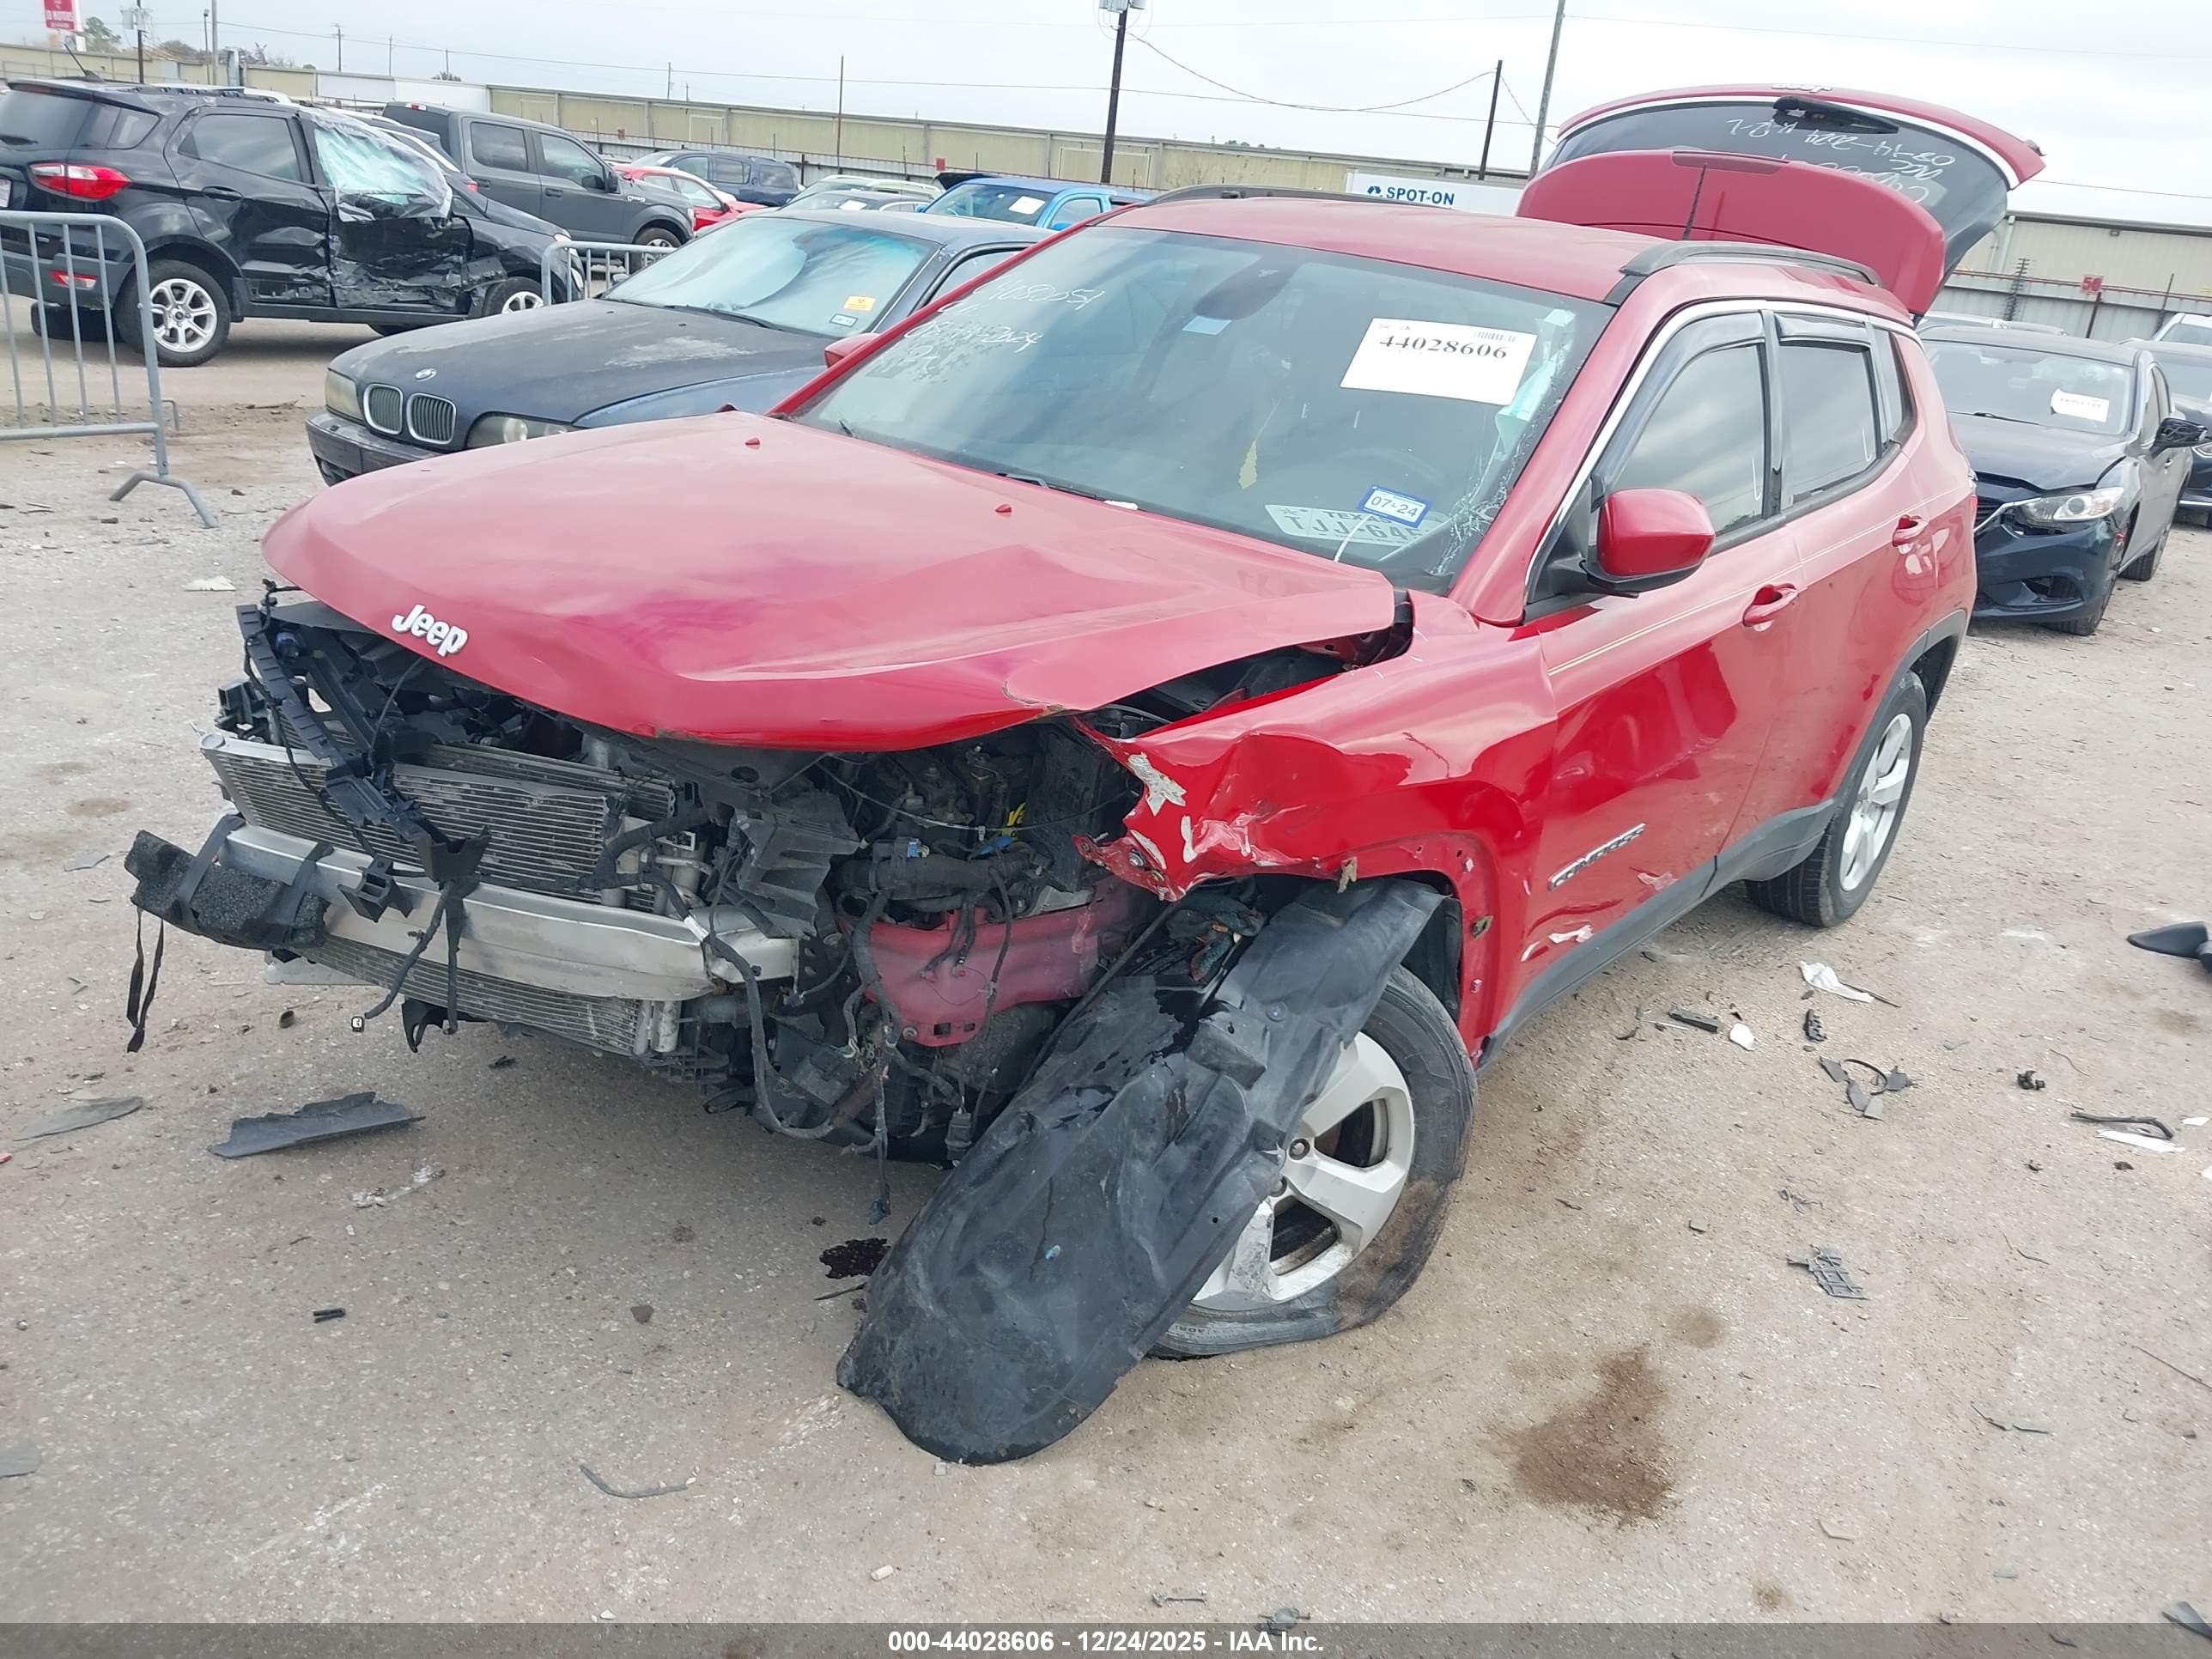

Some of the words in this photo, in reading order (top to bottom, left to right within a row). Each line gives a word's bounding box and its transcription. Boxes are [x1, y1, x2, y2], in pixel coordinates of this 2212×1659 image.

[1386, 186, 1455, 206] SPOT-ON
[1379, 335, 1508, 359] 44028606
[391, 604, 468, 657] Jeep
